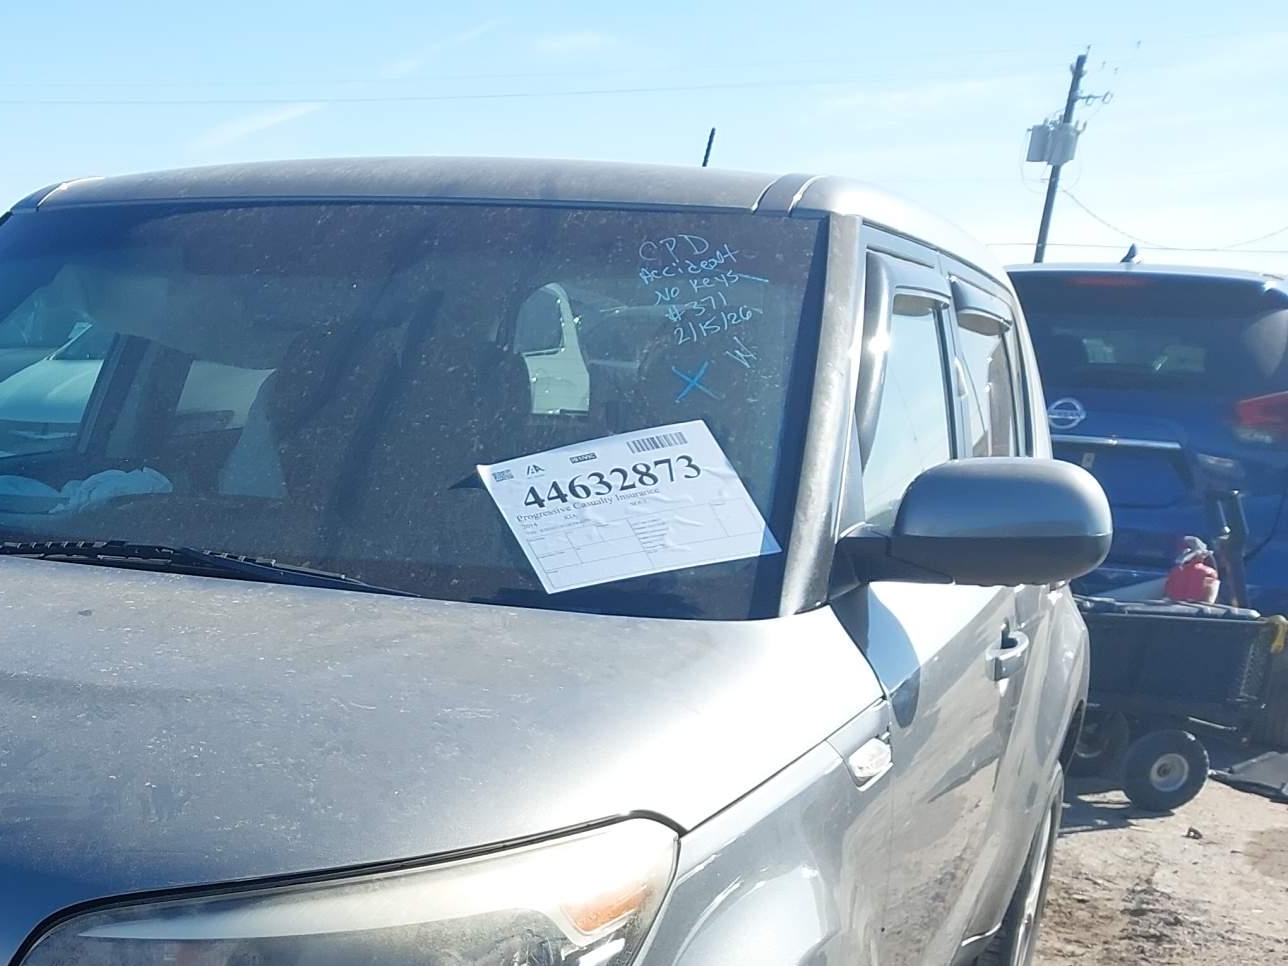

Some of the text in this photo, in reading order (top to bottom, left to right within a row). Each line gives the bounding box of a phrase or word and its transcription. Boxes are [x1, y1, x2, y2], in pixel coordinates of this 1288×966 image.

[639, 234, 710, 263] CPD
[524, 455, 702, 509] 44632873
[516, 487, 661, 522] Progressive Casualty Insurance
